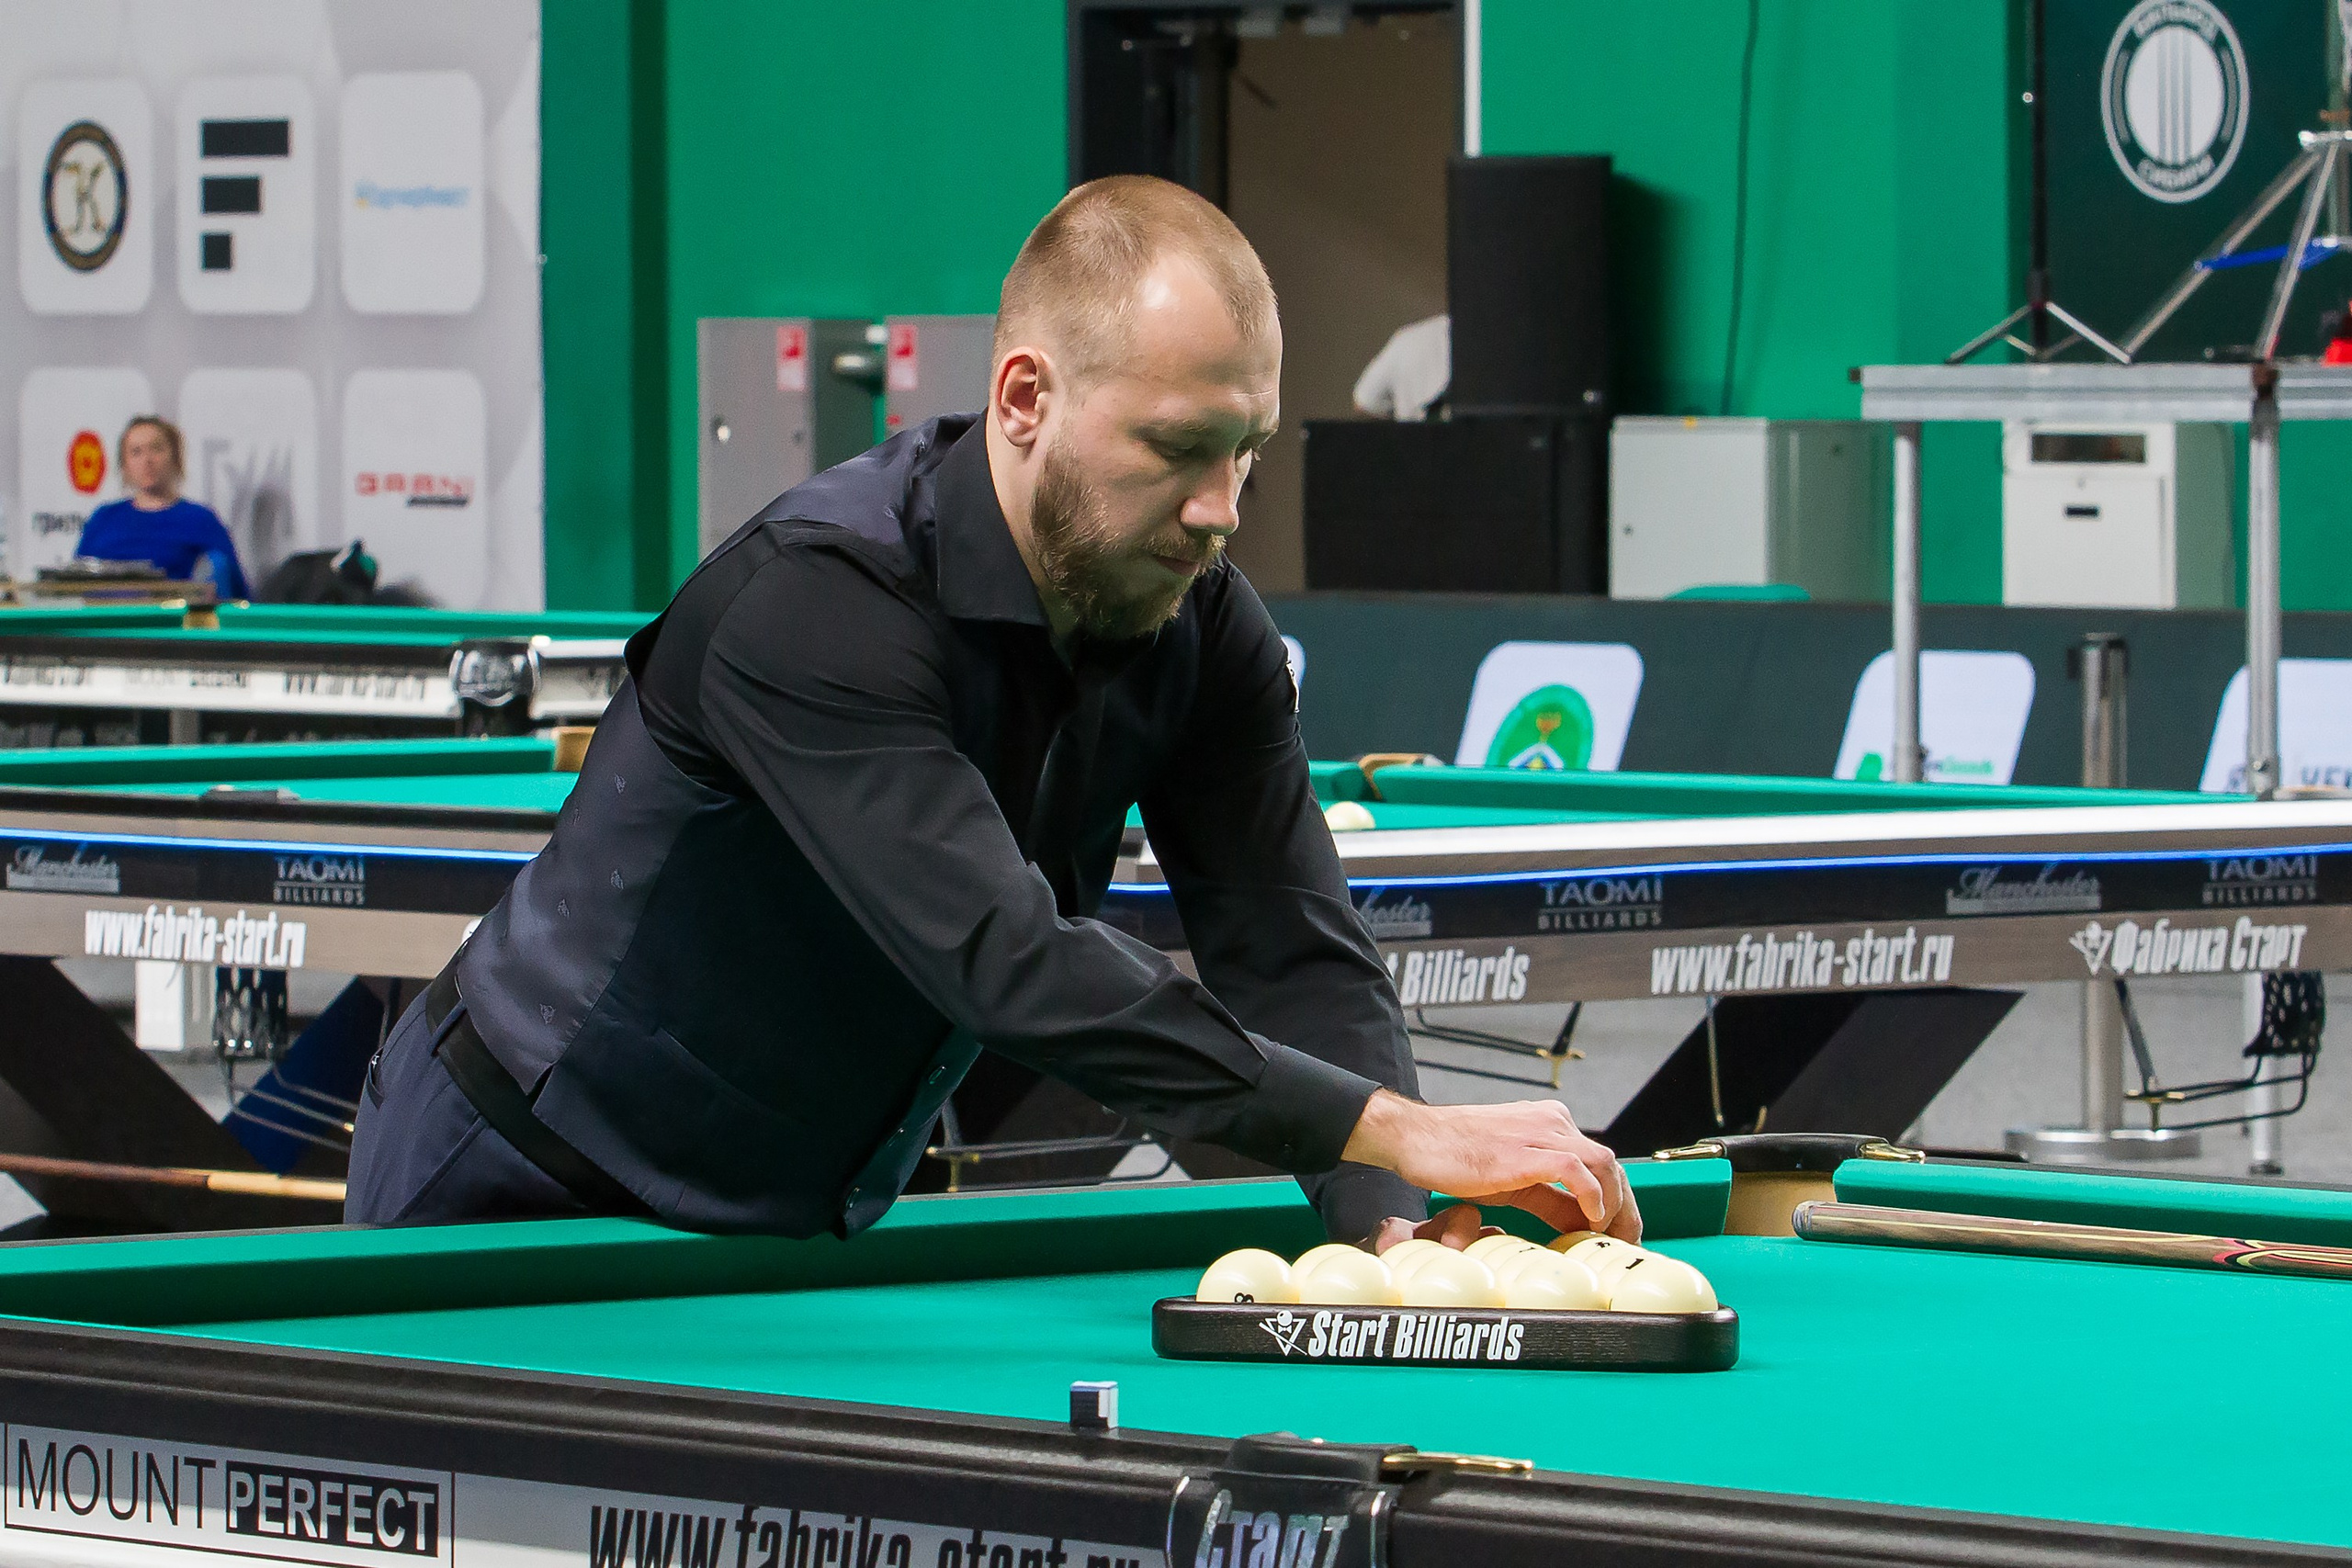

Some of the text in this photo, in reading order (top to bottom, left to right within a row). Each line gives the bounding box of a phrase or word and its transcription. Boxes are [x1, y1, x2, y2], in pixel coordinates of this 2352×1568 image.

[85, 903, 307, 968] www.fabrika-start.ru
[1650, 926, 1955, 995] www.fabrika-start.ru
[1400, 945, 1531, 1006] Billiards
[1307, 1310, 1525, 1361] Start Billiards
[17, 1438, 435, 1552] MOUNT PERFECT
